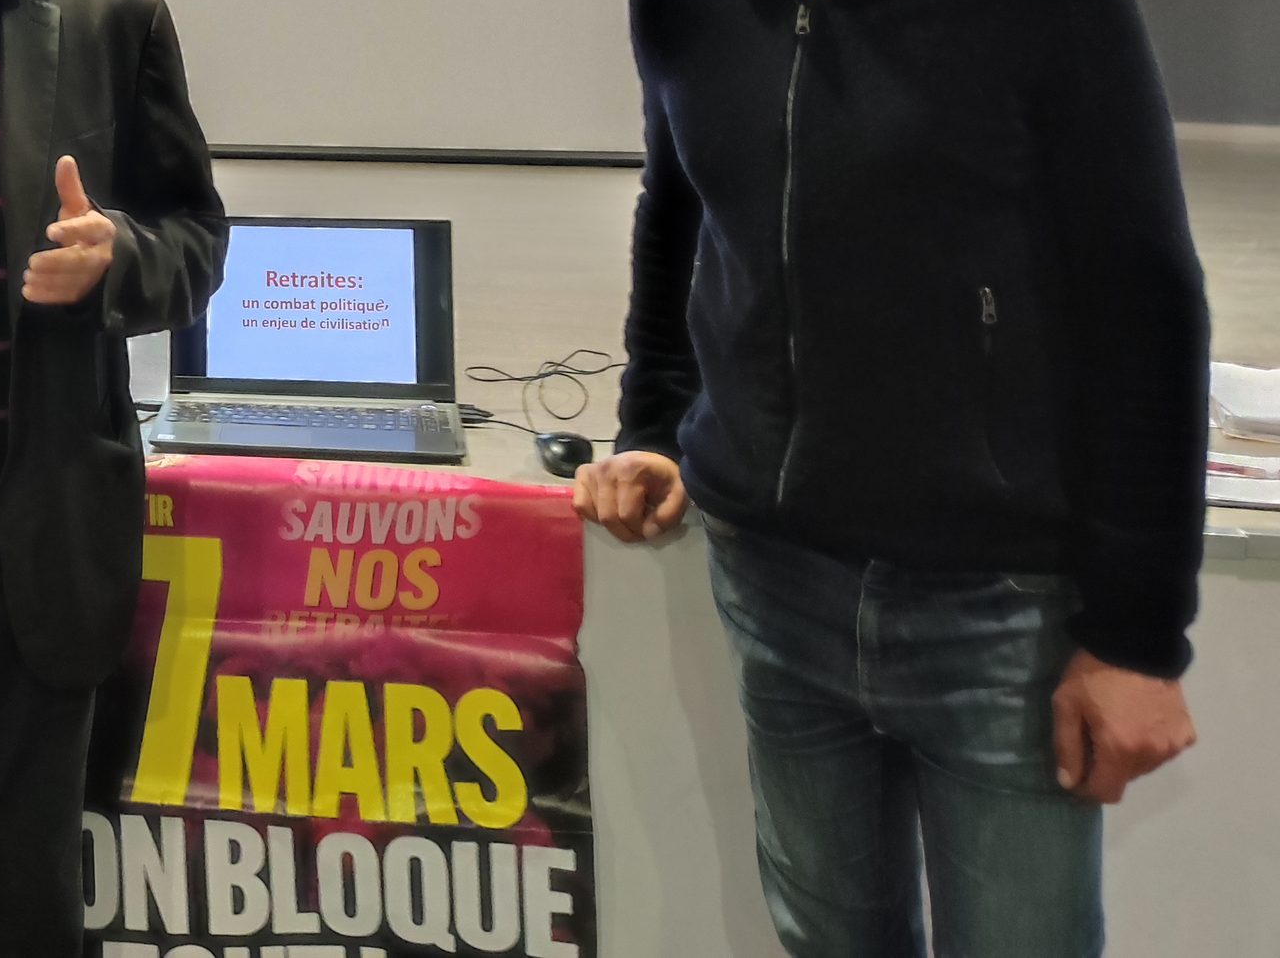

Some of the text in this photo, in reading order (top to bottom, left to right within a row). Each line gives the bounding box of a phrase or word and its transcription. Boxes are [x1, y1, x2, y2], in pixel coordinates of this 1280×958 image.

[266, 270, 364, 289] Retraites:
[242, 298, 389, 314] un combat politique,
[242, 317, 390, 331] un enjeu de civilisation
[279, 494, 483, 545] SAUVONS
[303, 547, 442, 611] NOS
[130, 534, 528, 830] 7 MARS
[203, 819, 581, 958] BLOQUE
